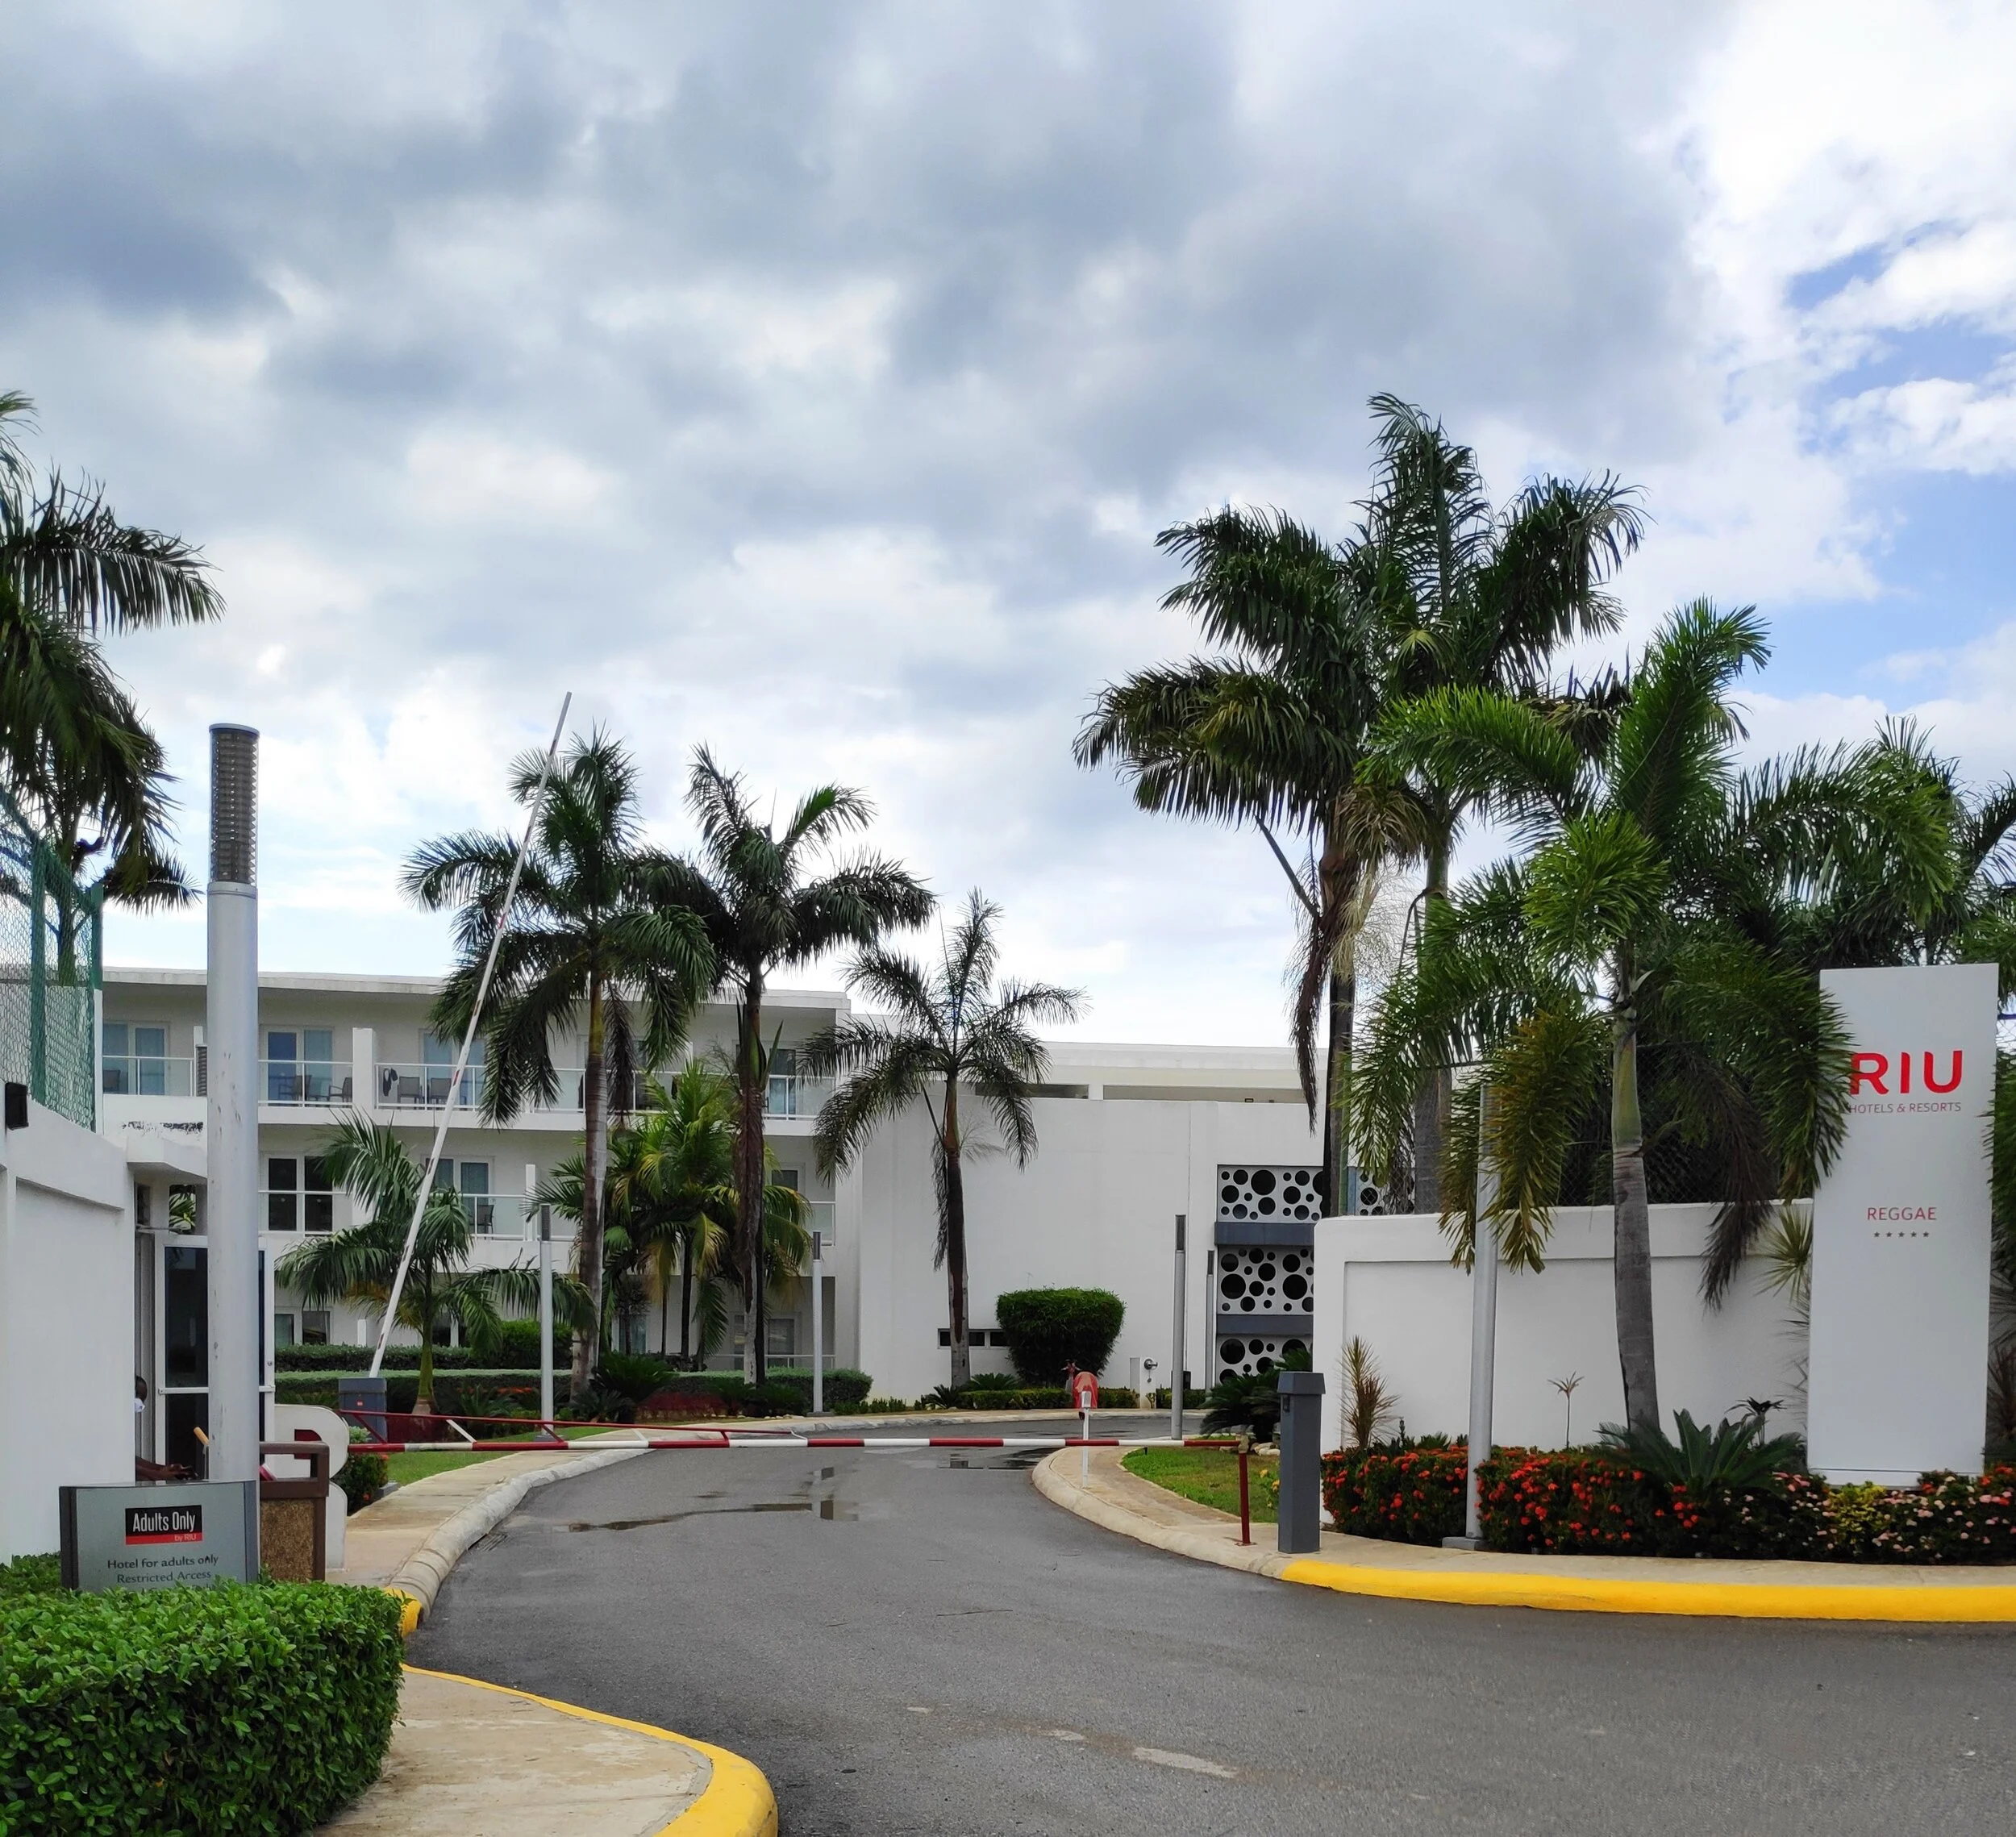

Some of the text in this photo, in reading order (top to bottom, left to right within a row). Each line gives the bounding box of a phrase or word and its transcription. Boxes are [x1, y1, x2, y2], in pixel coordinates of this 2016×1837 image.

[1849, 1050, 1963, 1095] RIU
[1850, 1102, 1962, 1114] HOTELS & RESORTS
[1867, 1206, 1937, 1221] REGGAE
[132, 1510, 196, 1533] Adults Only
[184, 1533, 197, 1541] RIU
[107, 1554, 219, 1569] Hotel for adults only
[117, 1571, 211, 1584] Restricted Access
